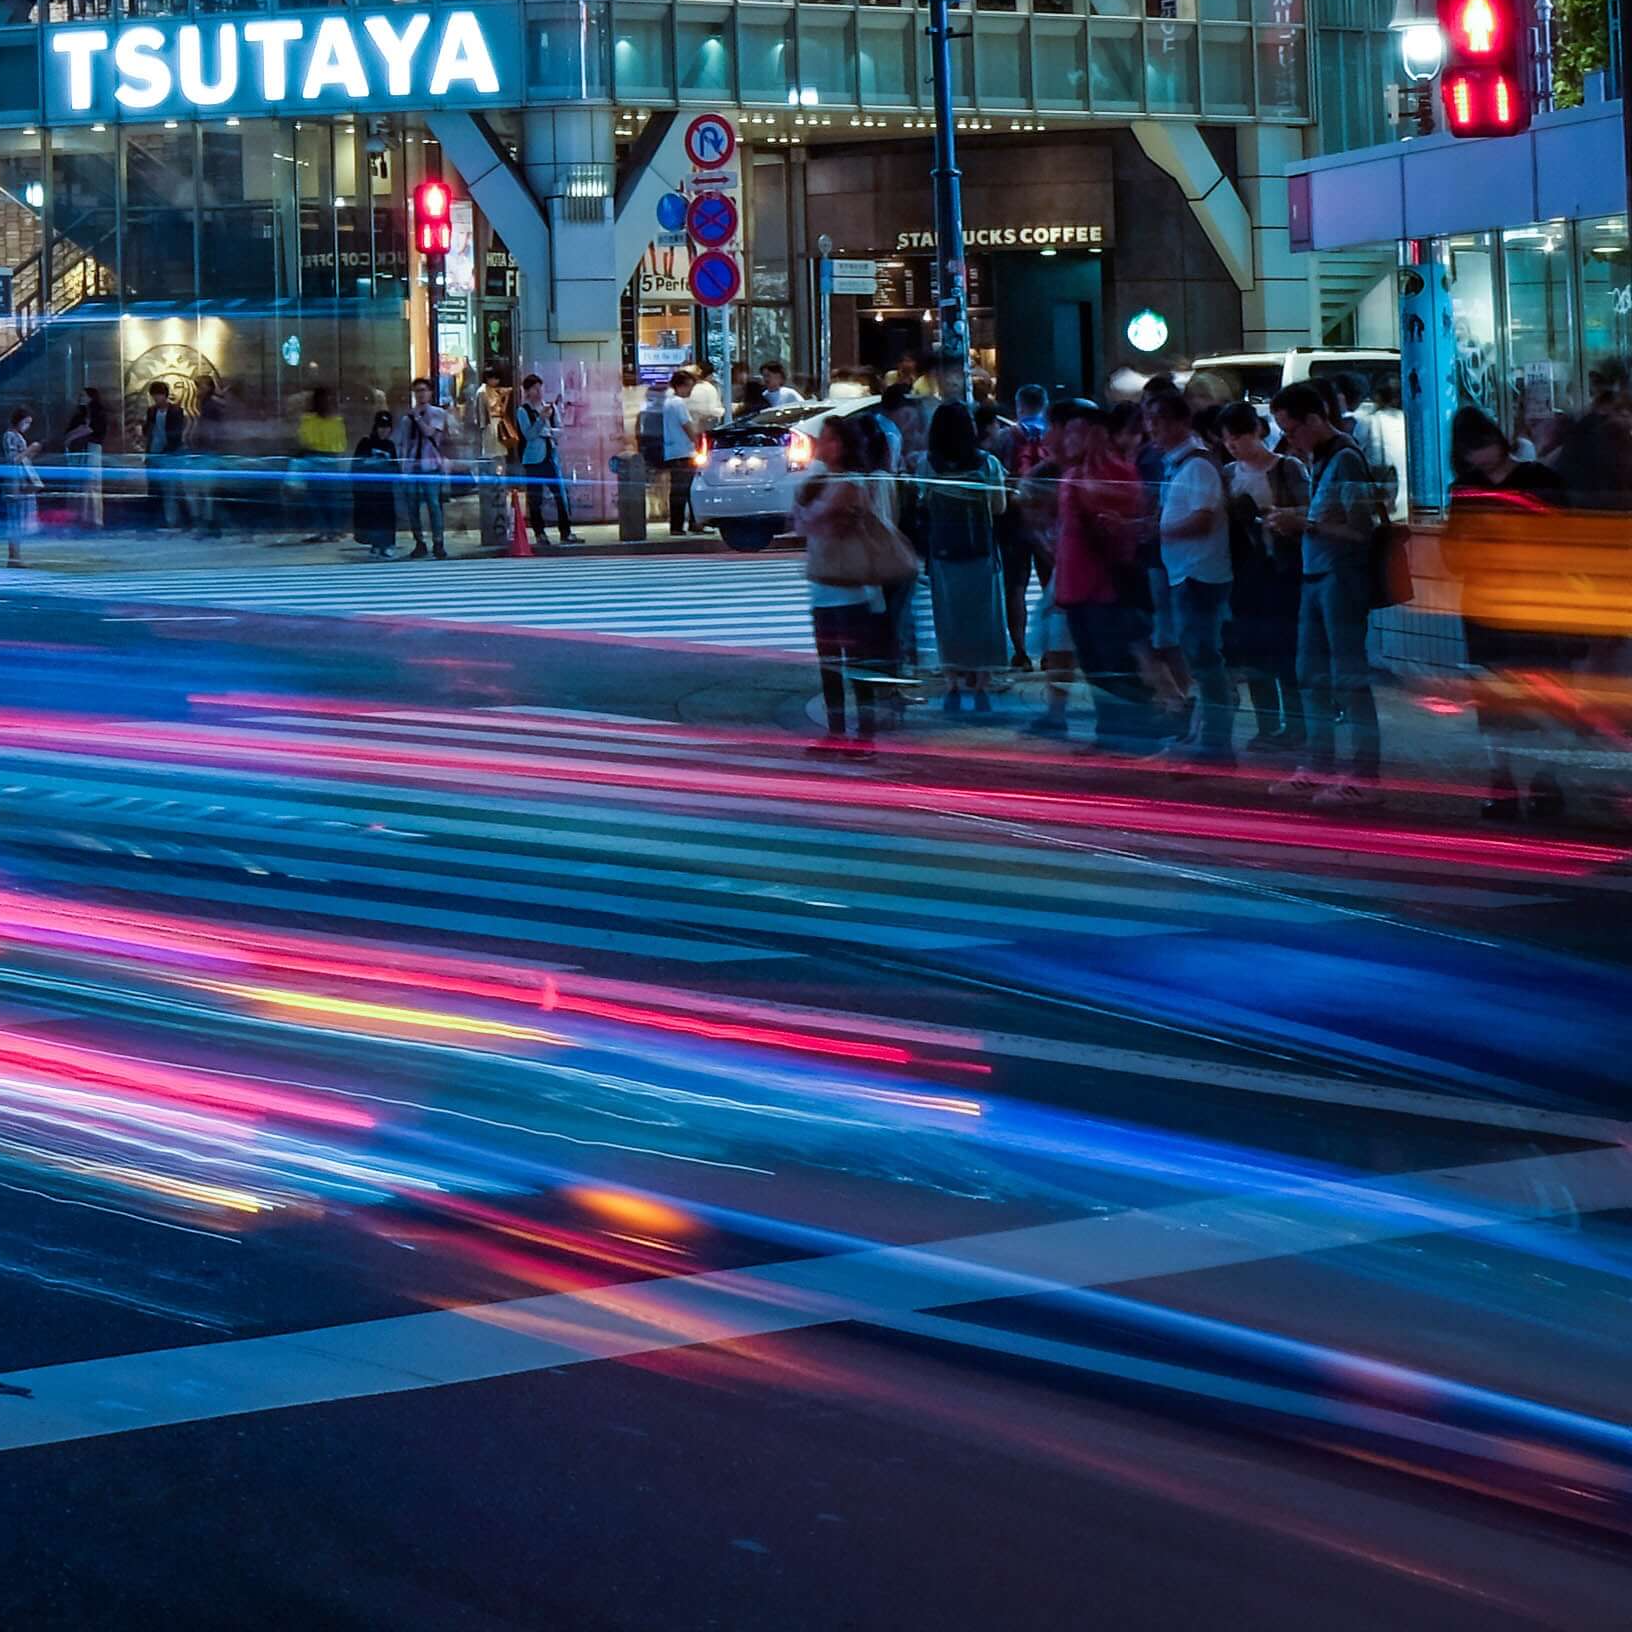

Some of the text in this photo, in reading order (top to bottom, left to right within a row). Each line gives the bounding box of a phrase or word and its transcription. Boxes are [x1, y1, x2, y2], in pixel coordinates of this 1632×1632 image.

[52, 11, 501, 111] TSUTAYA
[1019, 226, 1103, 243] COFFEE
[642, 274, 653, 292] 5
